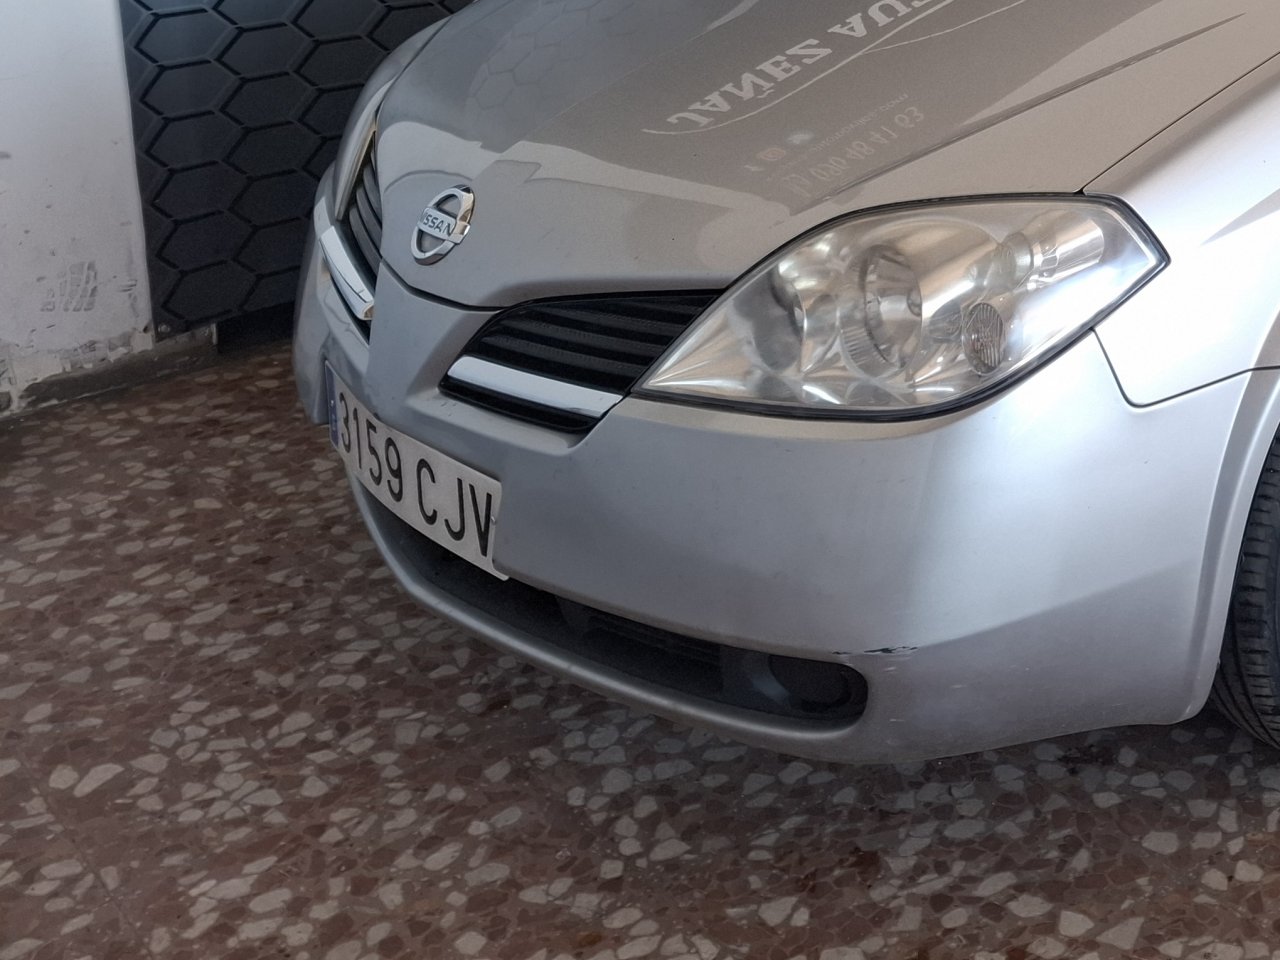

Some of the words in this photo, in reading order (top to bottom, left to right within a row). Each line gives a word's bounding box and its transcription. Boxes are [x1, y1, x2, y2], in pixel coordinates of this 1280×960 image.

[419, 209, 456, 237] ISSAN
[339, 392, 403, 502] 3159
[416, 457, 493, 558] CJV
